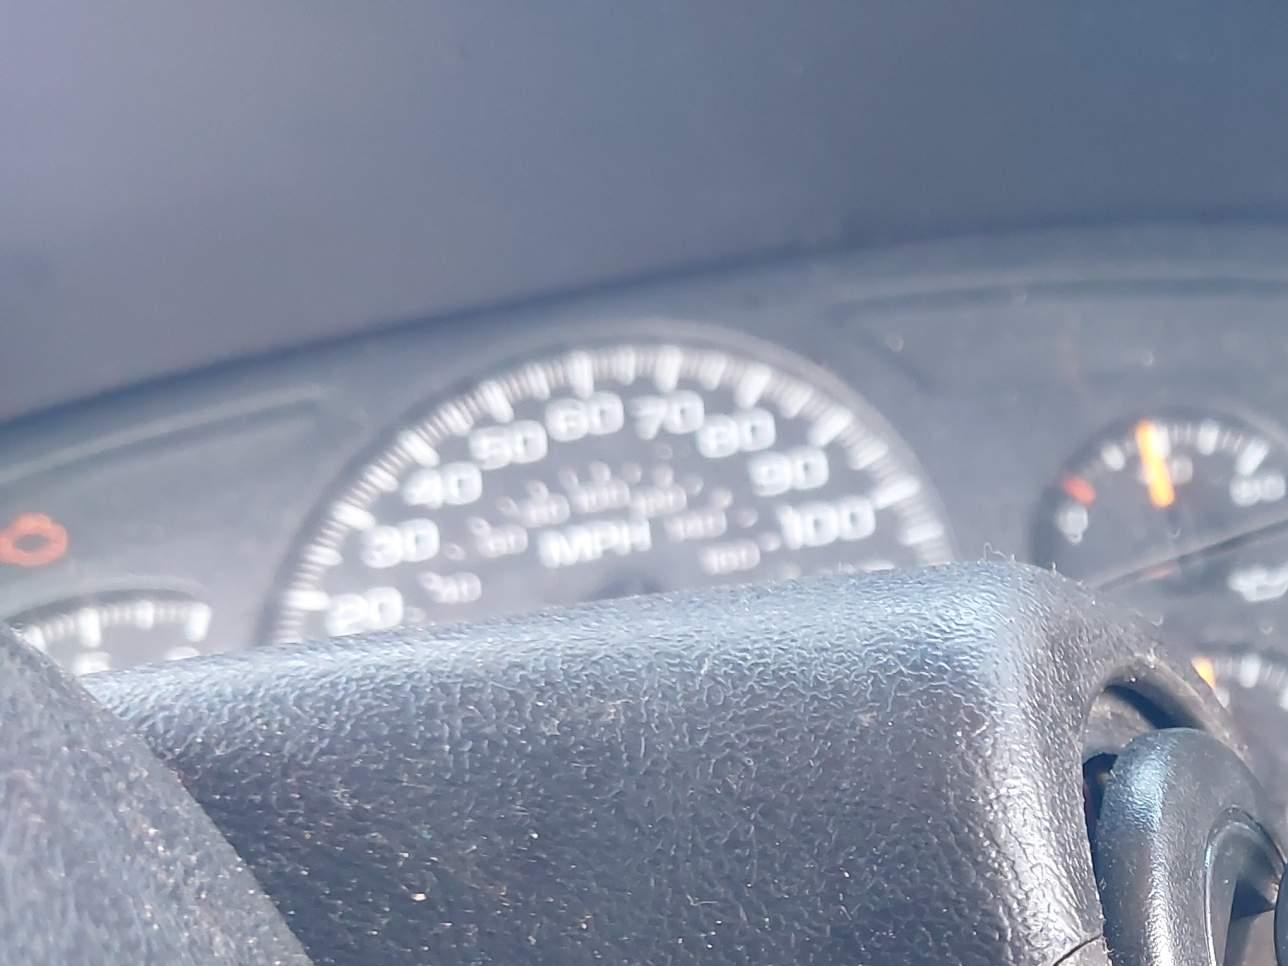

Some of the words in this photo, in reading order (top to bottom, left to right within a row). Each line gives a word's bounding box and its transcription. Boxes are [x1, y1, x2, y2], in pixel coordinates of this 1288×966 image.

[545, 391, 625, 442] 60
[627, 389, 705, 440] 70
[697, 407, 776, 459] 80
[469, 419, 548, 469] 50
[403, 461, 482, 509] 40
[750, 447, 829, 497] 90
[361, 518, 440, 568] 30
[537, 517, 651, 568] MPH
[777, 497, 876, 550] 100
[325, 587, 403, 637] 20
